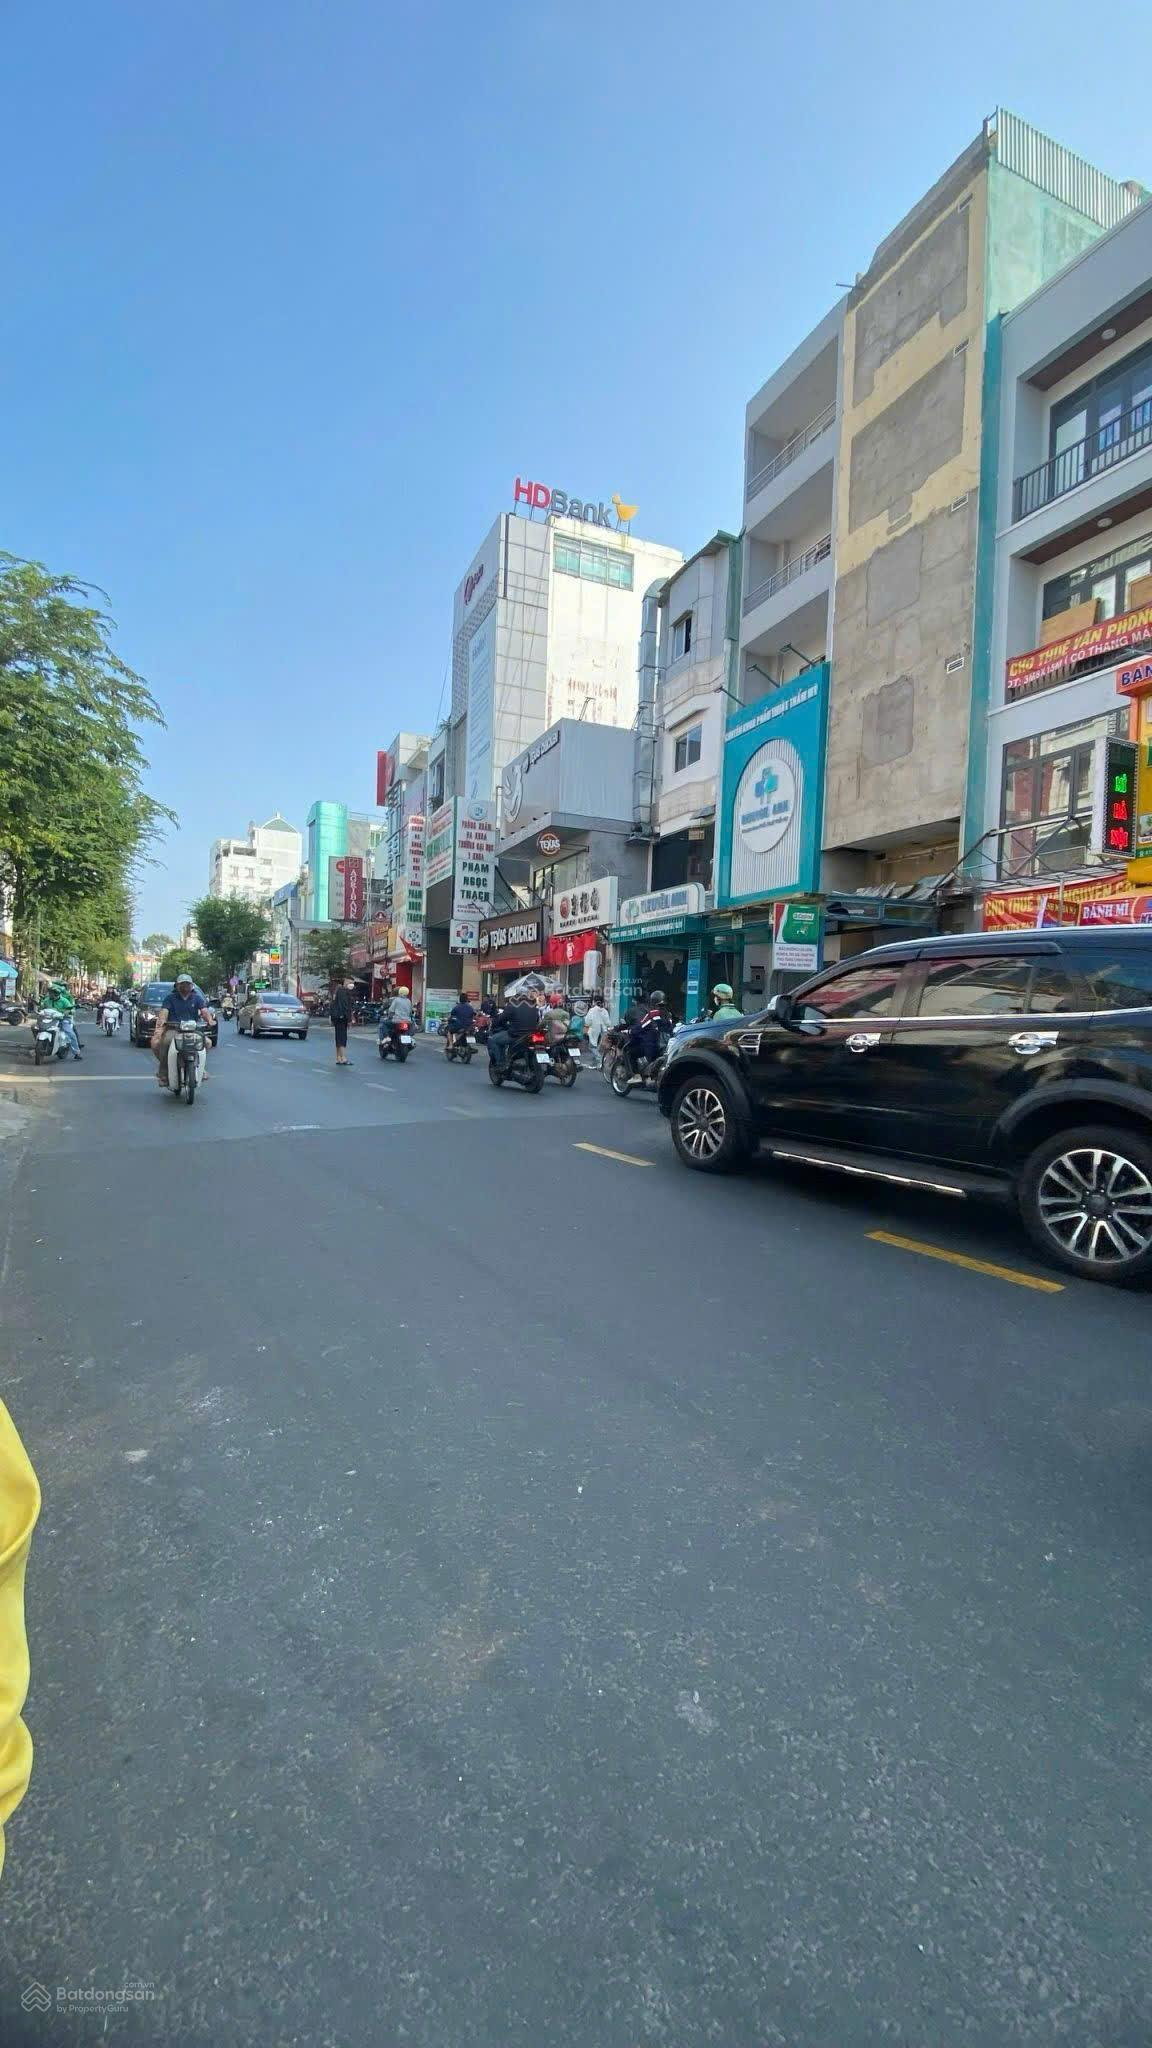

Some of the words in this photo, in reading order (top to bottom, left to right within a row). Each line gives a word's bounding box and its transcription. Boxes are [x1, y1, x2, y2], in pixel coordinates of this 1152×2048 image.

[514, 477, 612, 527] HDBank
[1009, 658, 1035, 676] CHO
[539, 839, 560, 851] TEXAS
[462, 862, 489, 876] PHẠM
[463, 876, 488, 889] NGỌC
[461, 889, 490, 902] THẠCH
[1083, 902, 1113, 919] BÁNH
[490, 928, 507, 949] TEXAS
[507, 922, 538, 945] CHICKEN
